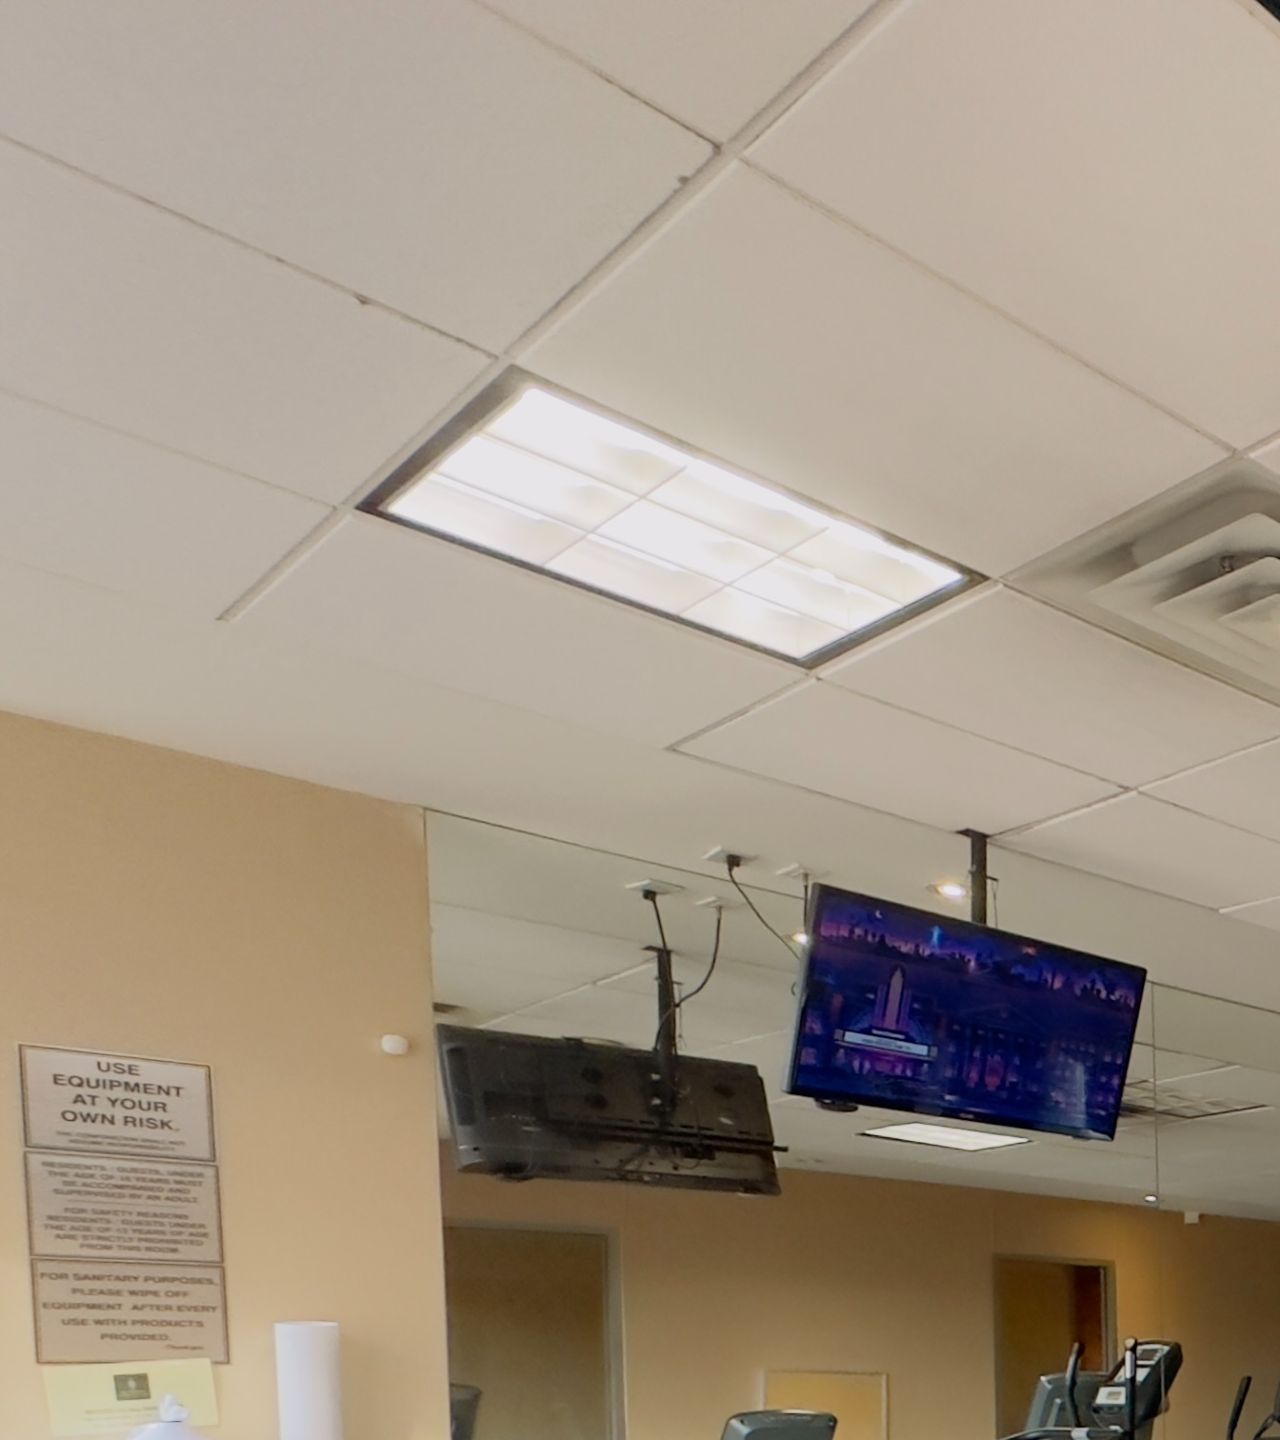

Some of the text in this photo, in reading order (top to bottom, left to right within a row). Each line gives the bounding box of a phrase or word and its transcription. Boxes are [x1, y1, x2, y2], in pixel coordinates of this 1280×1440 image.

[97, 1061, 140, 1076] USE
[53, 1074, 183, 1097] EQUIPMENT
[73, 1094, 167, 1113] AT YOUR
[61, 1110, 180, 1132] OWN RISK.
[40, 1272, 69, 1281] FOR
[72, 1273, 139, 1283] SANITARY
[71, 1287, 189, 1299] PLEASE WIPE OFF
[42, 1302, 218, 1313] EQUIPMENT AFTER EVERY
[61, 1318, 204, 1328] USE WITH PRODUCTS
[100, 1332, 172, 1342] PROVIDED.
